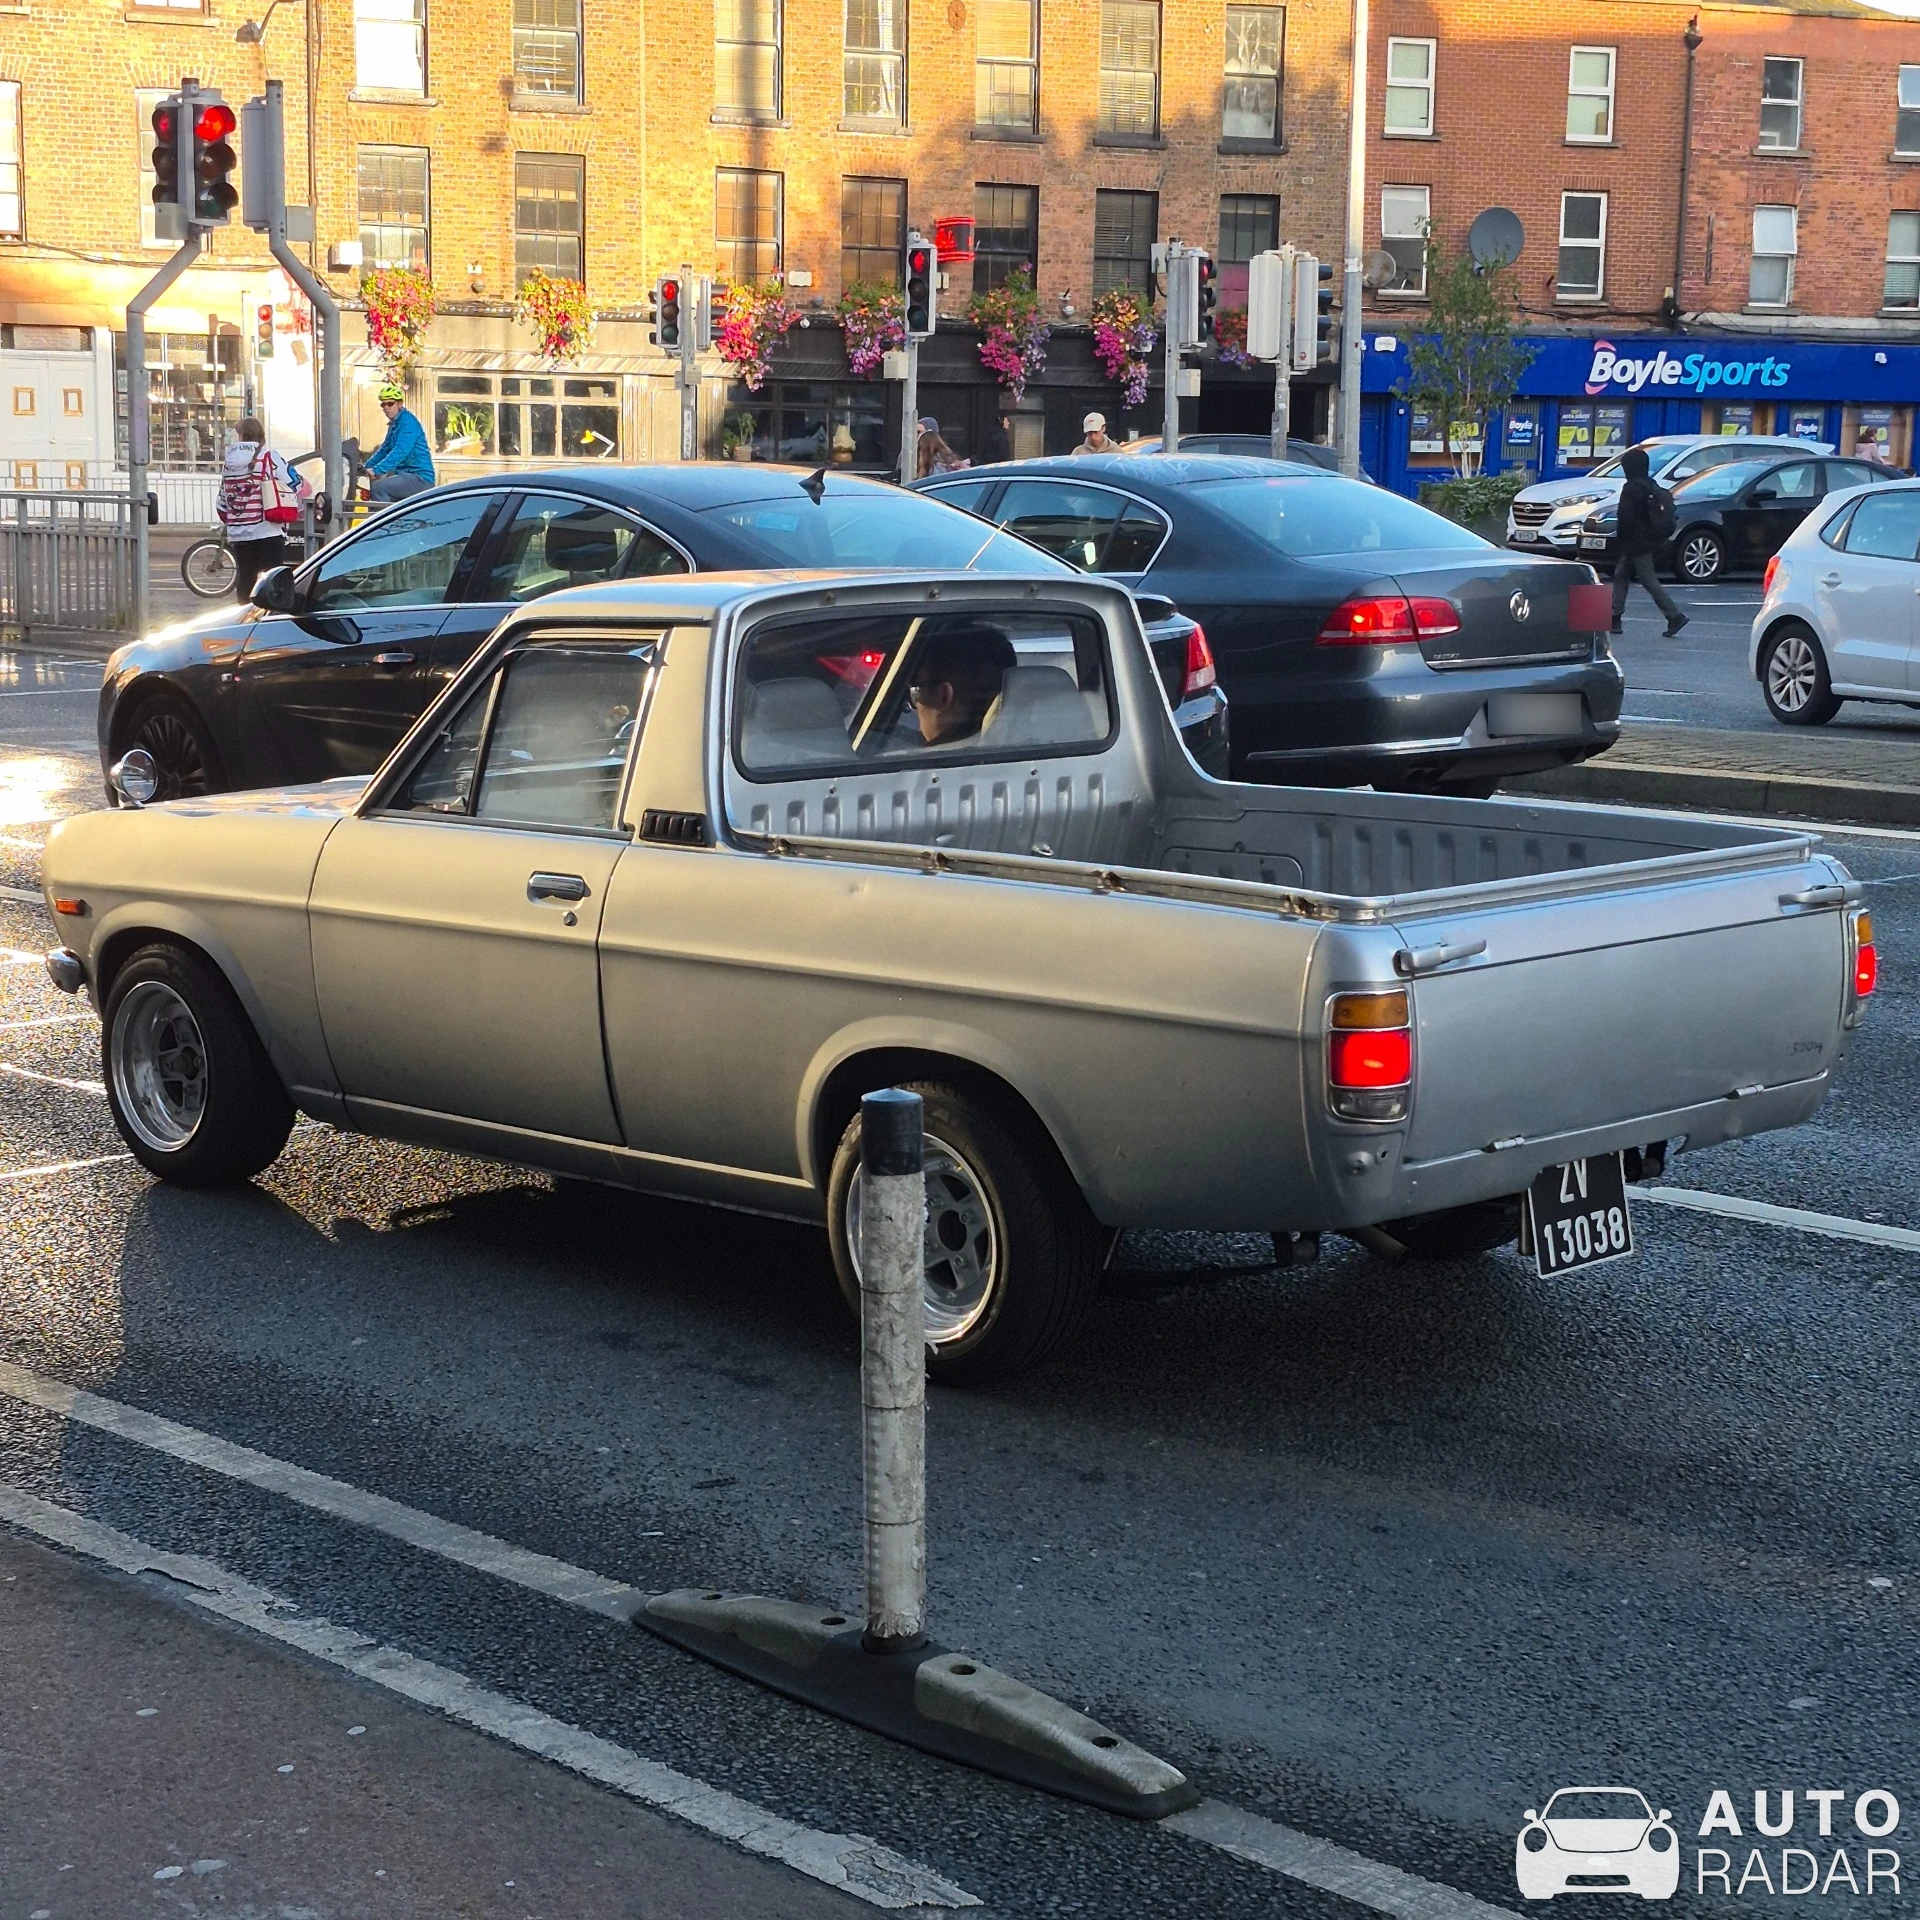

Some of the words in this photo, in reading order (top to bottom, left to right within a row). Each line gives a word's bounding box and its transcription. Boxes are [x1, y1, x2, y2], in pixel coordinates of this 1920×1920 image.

[1588, 350, 1791, 393] BoyleSports
[1508, 419, 1533, 432] Boyle
[1556, 1157, 1587, 1204] ZV
[1543, 1206, 1626, 1268] 13038
